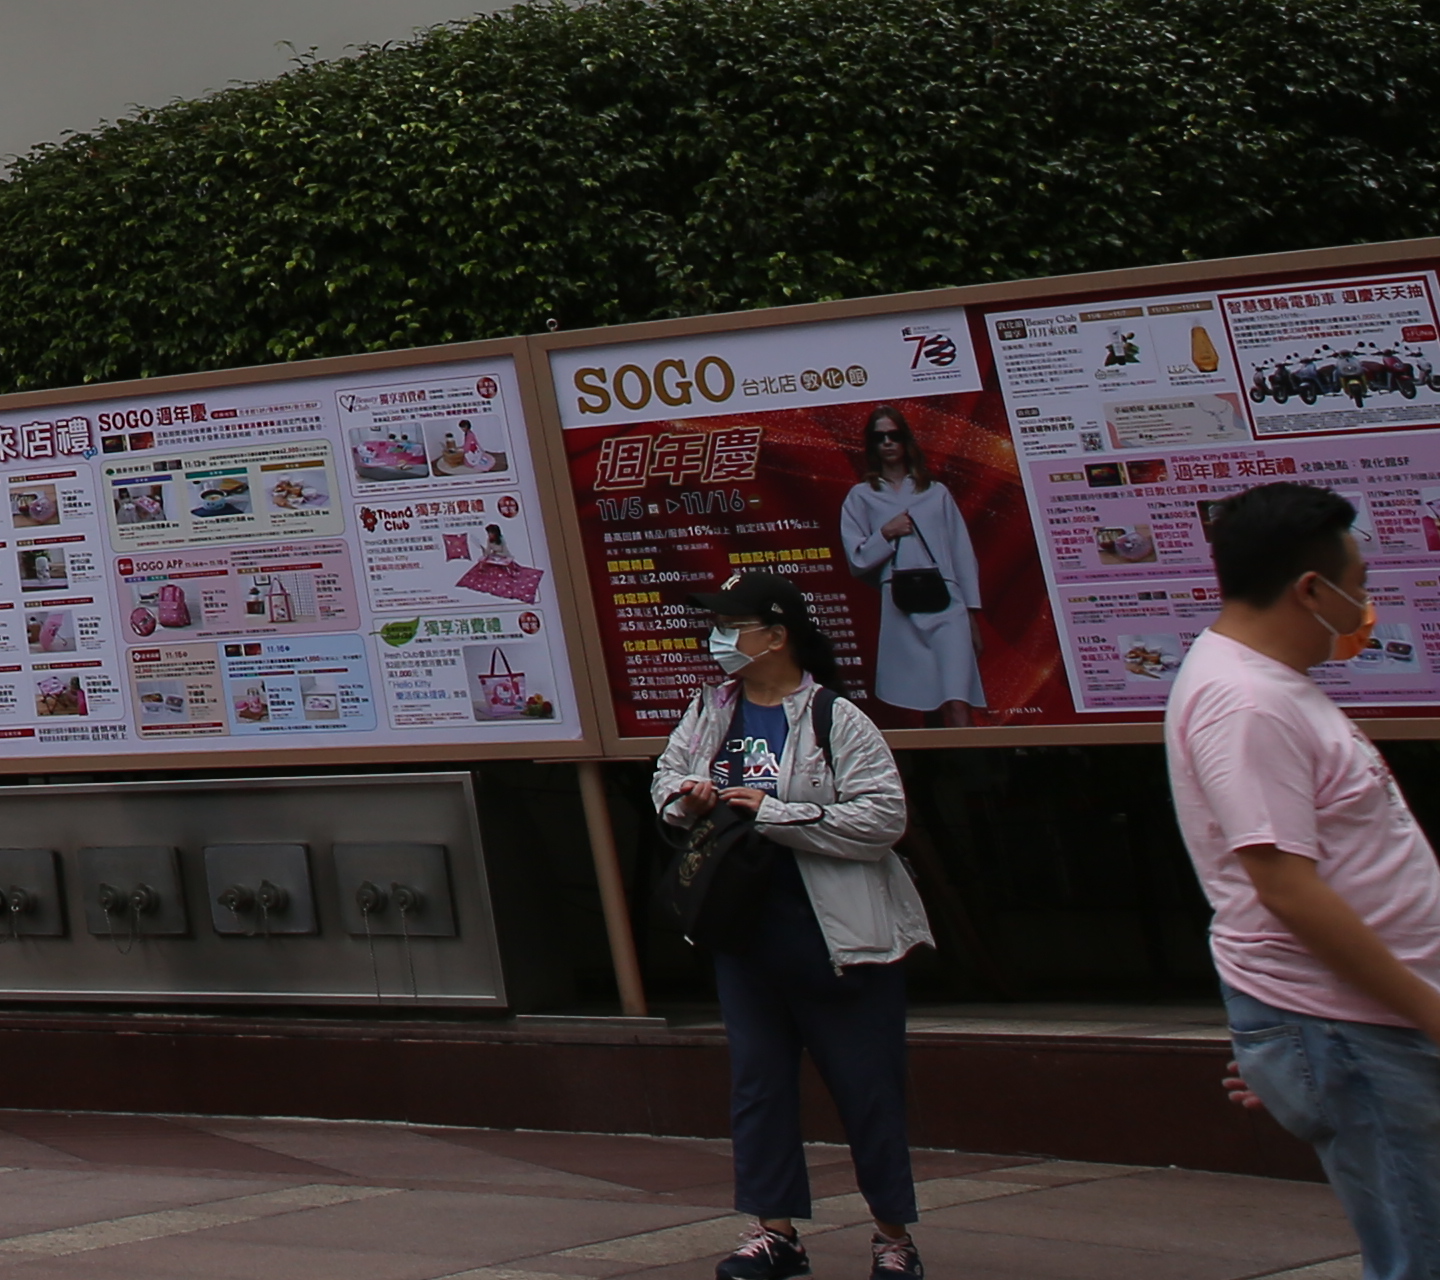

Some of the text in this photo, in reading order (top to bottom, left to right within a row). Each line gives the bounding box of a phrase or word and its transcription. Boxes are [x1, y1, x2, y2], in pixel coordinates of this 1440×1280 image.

[1226, 283, 1425, 315] 智慧雙輪電動車 週慶天天抽
[1026, 314, 1078, 330] Beauty Club
[573, 355, 868, 414] SOGO 台北店 敦化館
[98, 409, 154, 432] SOGO
[157, 403, 208, 426] 週年慶
[593, 425, 764, 491] 週年慶
[1174, 461, 1233, 481] 週年慶
[1236, 456, 1298, 477] 來店禮
[415, 498, 486, 517] 獨享消費禮
[594, 495, 645, 522] 11/5
[680, 488, 746, 516] 11/16
[1373, 508, 1417, 518] Hello Kitty
[384, 520, 410, 532] Club
[1050, 526, 1091, 537] Hello Kitty
[1152, 520, 1194, 531] Hello Kitty
[135, 558, 183, 572] SOGO APP
[423, 616, 503, 636] 獨享消費禮
[1078, 644, 1116, 655] Hello Kitty
